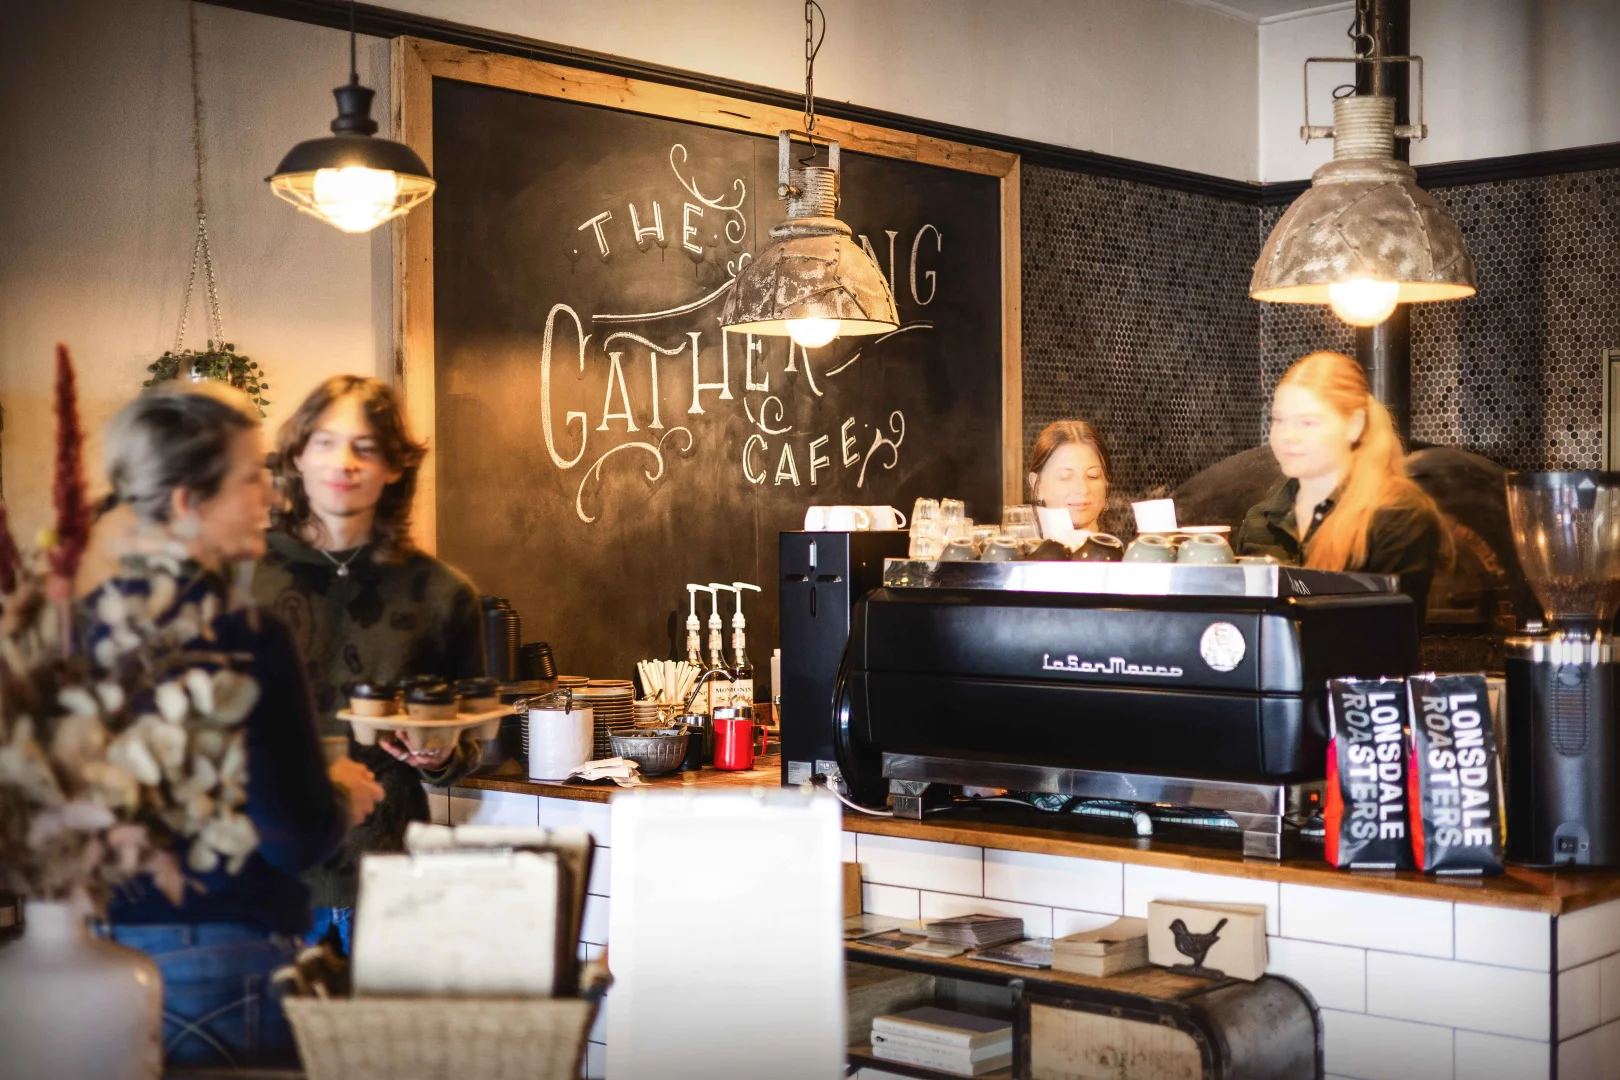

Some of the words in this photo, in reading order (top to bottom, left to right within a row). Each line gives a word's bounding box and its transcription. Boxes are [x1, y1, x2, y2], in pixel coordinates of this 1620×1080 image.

[578, 200, 704, 257] THE
[540, 224, 942, 470] GATHENG
[742, 416, 861, 486] CAFE
[1341, 693, 1378, 840] ROASTERS
[1368, 693, 1405, 840] LONSDALE
[1421, 695, 1463, 848] ROASTERS
[1449, 694, 1493, 847] LONSDALE
